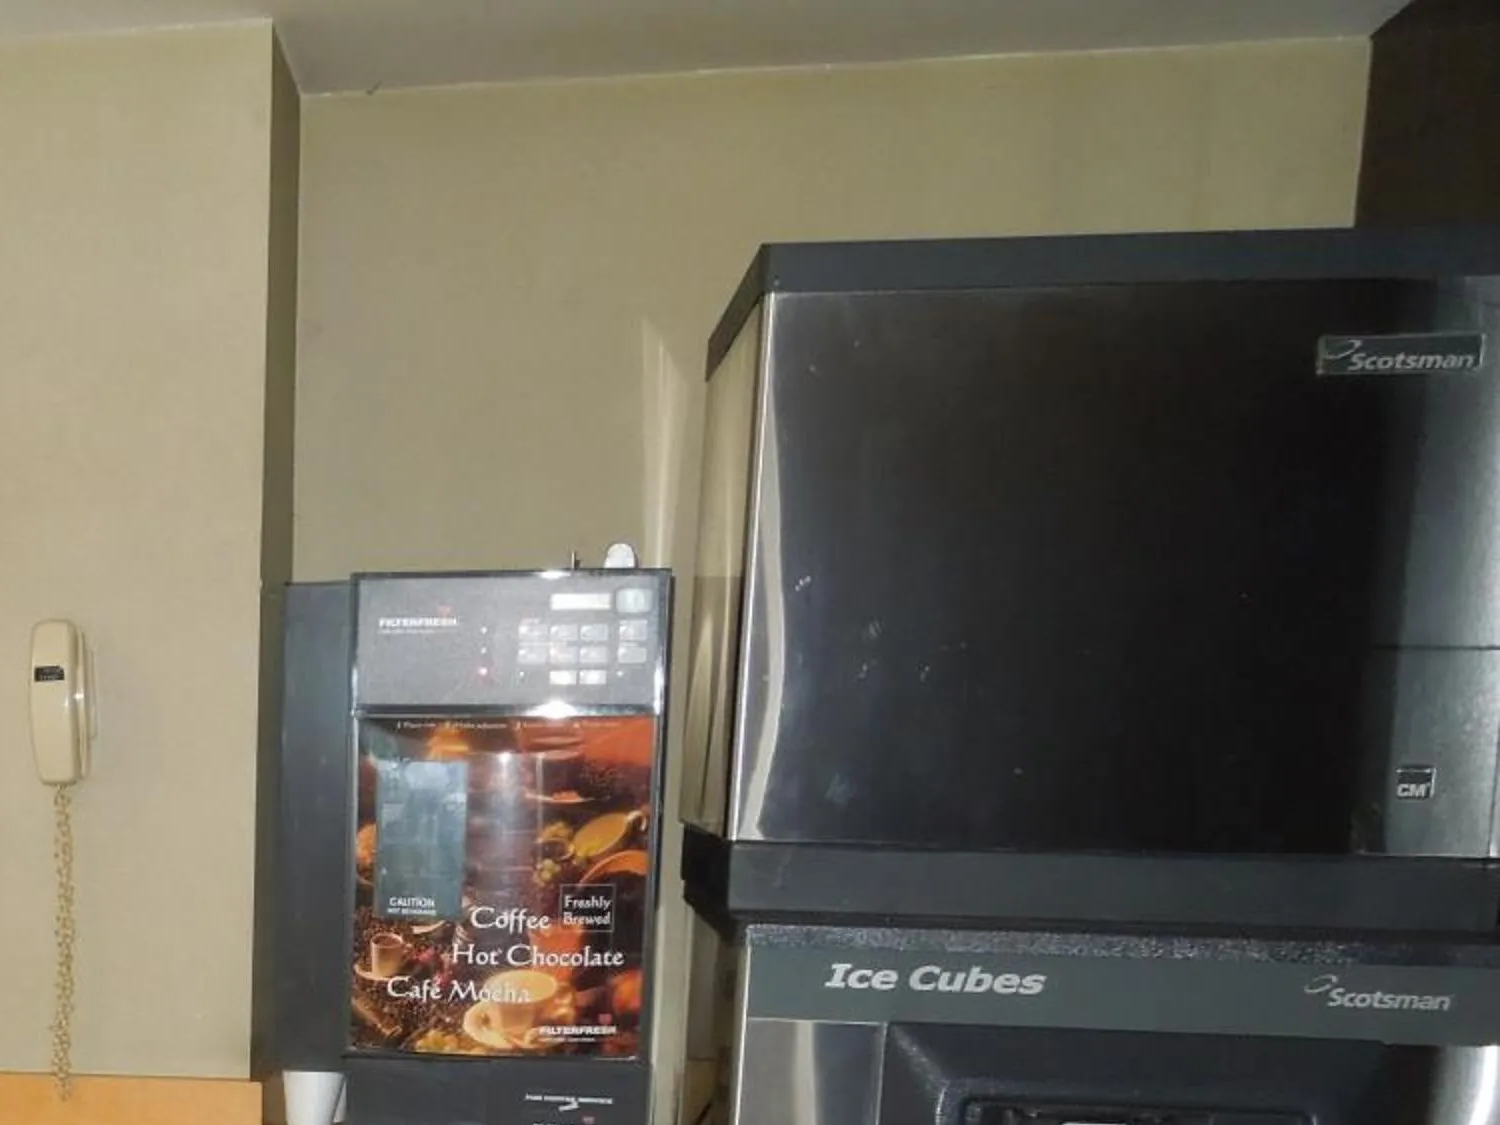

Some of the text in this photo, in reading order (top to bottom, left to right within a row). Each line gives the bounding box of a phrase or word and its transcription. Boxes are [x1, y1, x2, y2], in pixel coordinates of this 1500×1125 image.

[1347, 352, 1476, 371] Scotsman
[389, 896, 435, 909] CAUTION
[563, 895, 612, 912] Freshly
[470, 906, 551, 935] Coffee
[563, 911, 612, 926] Brewed
[452, 944, 625, 969] Hot Chocolate
[387, 975, 532, 1003] Café Mocha
[825, 963, 1046, 996] Ice Cubes
[1327, 986, 1451, 1012] Scotsman
